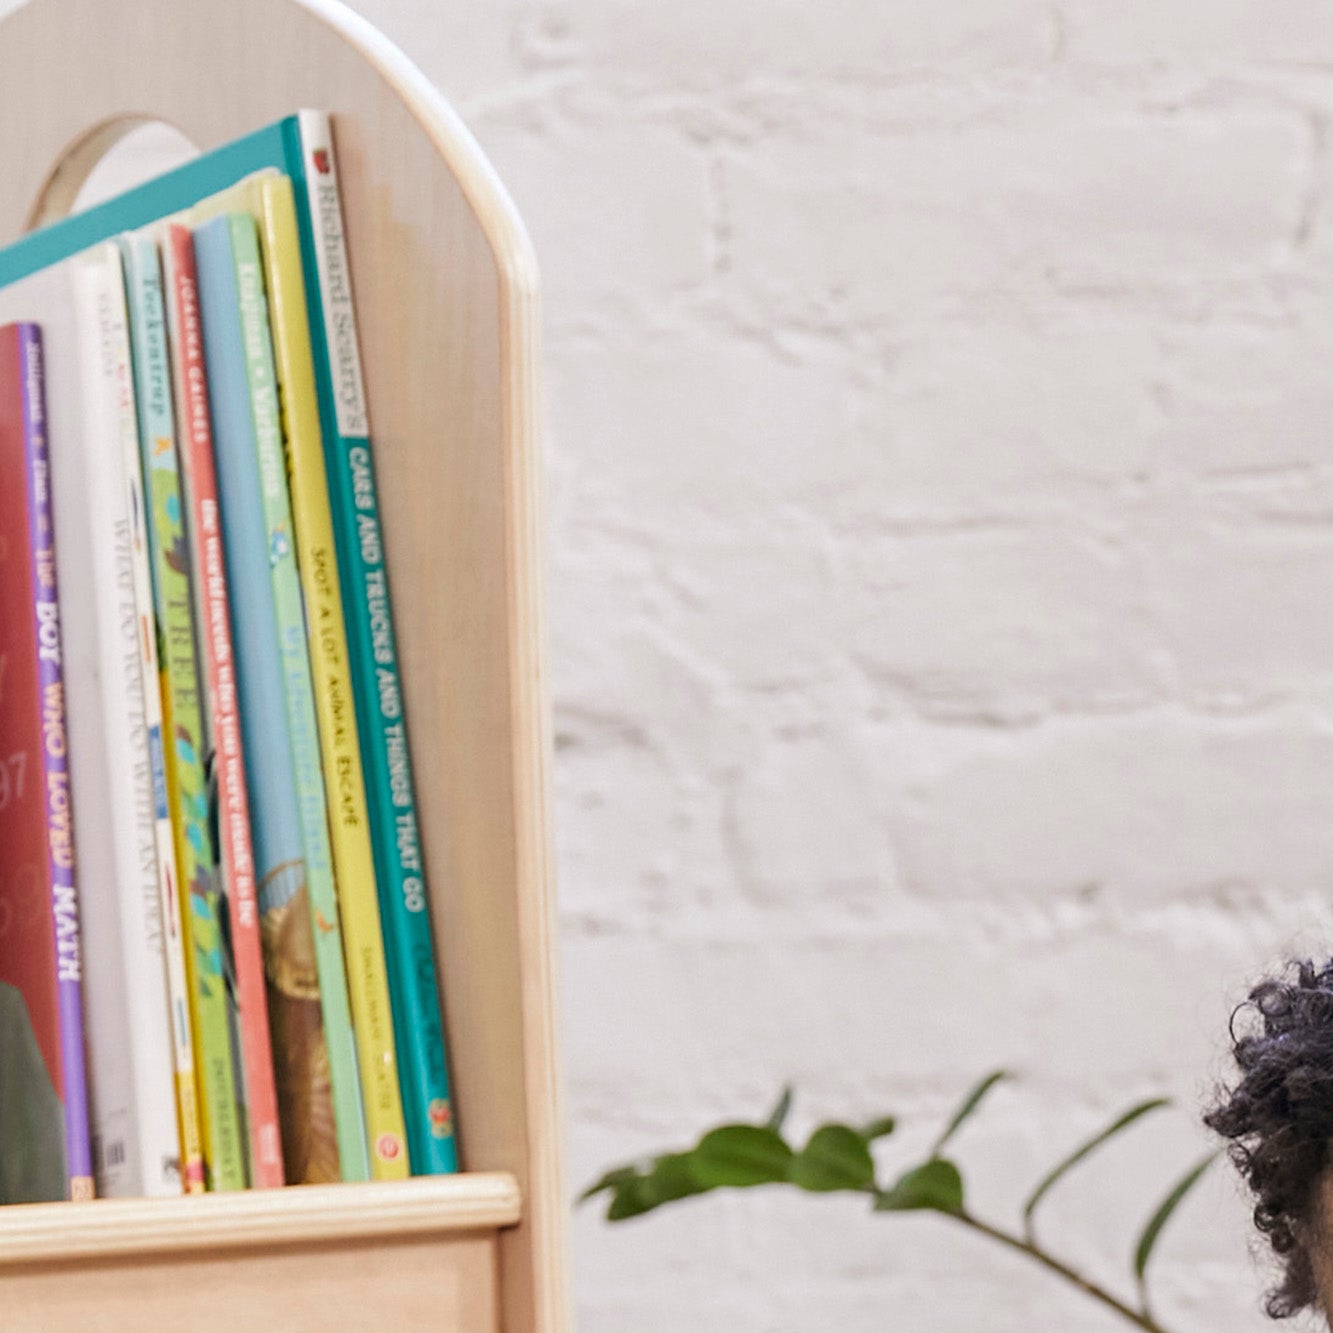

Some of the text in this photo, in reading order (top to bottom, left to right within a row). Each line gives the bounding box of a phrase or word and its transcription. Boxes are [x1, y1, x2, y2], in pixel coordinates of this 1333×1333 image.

[35, 601, 59, 664] BOY
[348, 446, 424, 911] CARS AND TRUCKS AND THINGS THAT GO
[41, 682, 65, 756] WHO
[45, 770, 72, 867] LOVED
[51, 883, 80, 979] MATH
